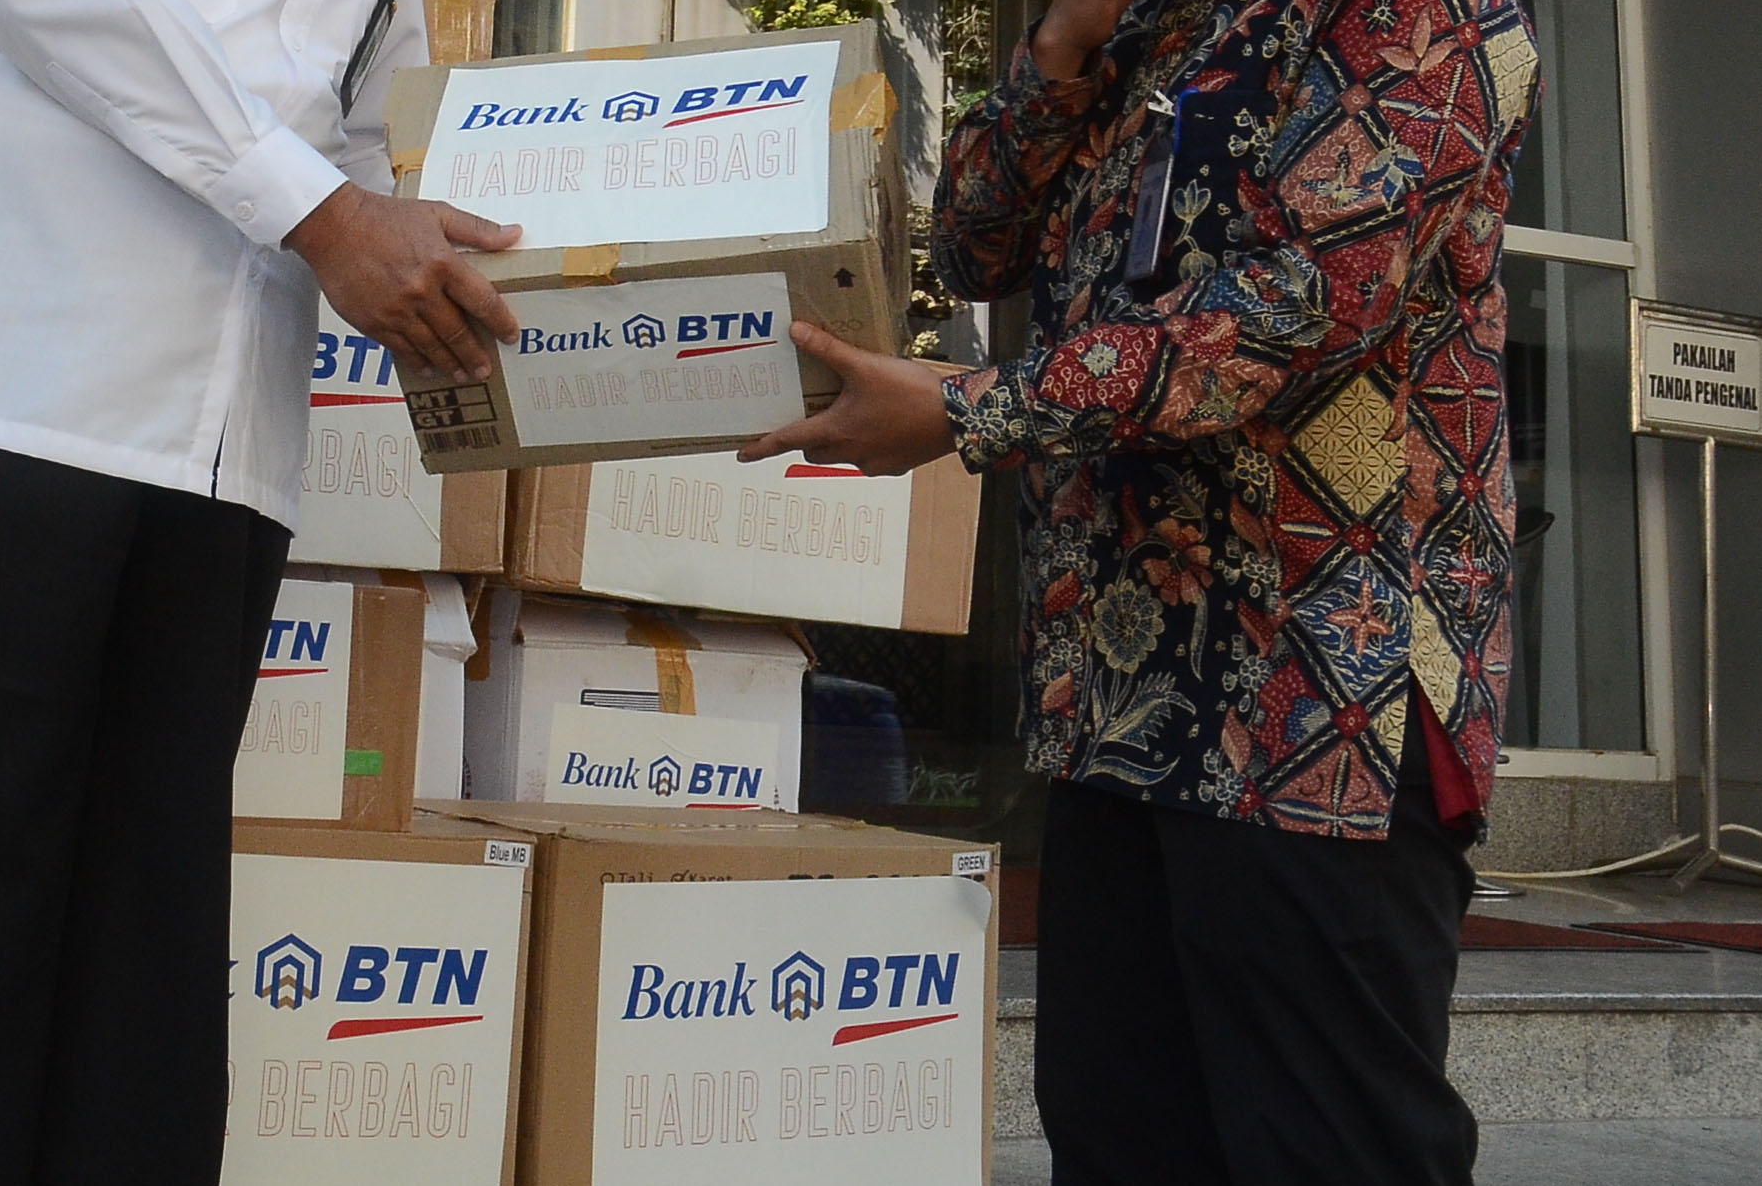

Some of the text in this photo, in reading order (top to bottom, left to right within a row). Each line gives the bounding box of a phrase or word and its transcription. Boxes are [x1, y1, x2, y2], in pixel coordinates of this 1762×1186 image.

[457, 75, 808, 131] Bank BTN
[449, 128, 796, 198] HADIR BERBAGI
[519, 311, 772, 354] Bank BTN
[1673, 342, 1736, 373] PAKAILAH
[409, 391, 449, 408] MT
[529, 362, 780, 410] HADIR BERBAGI
[1649, 374, 1758, 411] TANDA PENGENAL
[416, 410, 453, 427] GT
[611, 469, 884, 565] HADIR BERBAGI
[265, 620, 331, 662] TN
[562, 751, 640, 789] Bank
[688, 763, 762, 798] BTN
[489, 844, 526, 863] Blue MB
[958, 856, 985, 871] GREEN
[336, 945, 488, 1005] BTN
[622, 953, 960, 1020] Bank BTN
[257, 1060, 472, 1138] BERBAGI
[624, 1058, 952, 1148] HADIR BERBAGI
